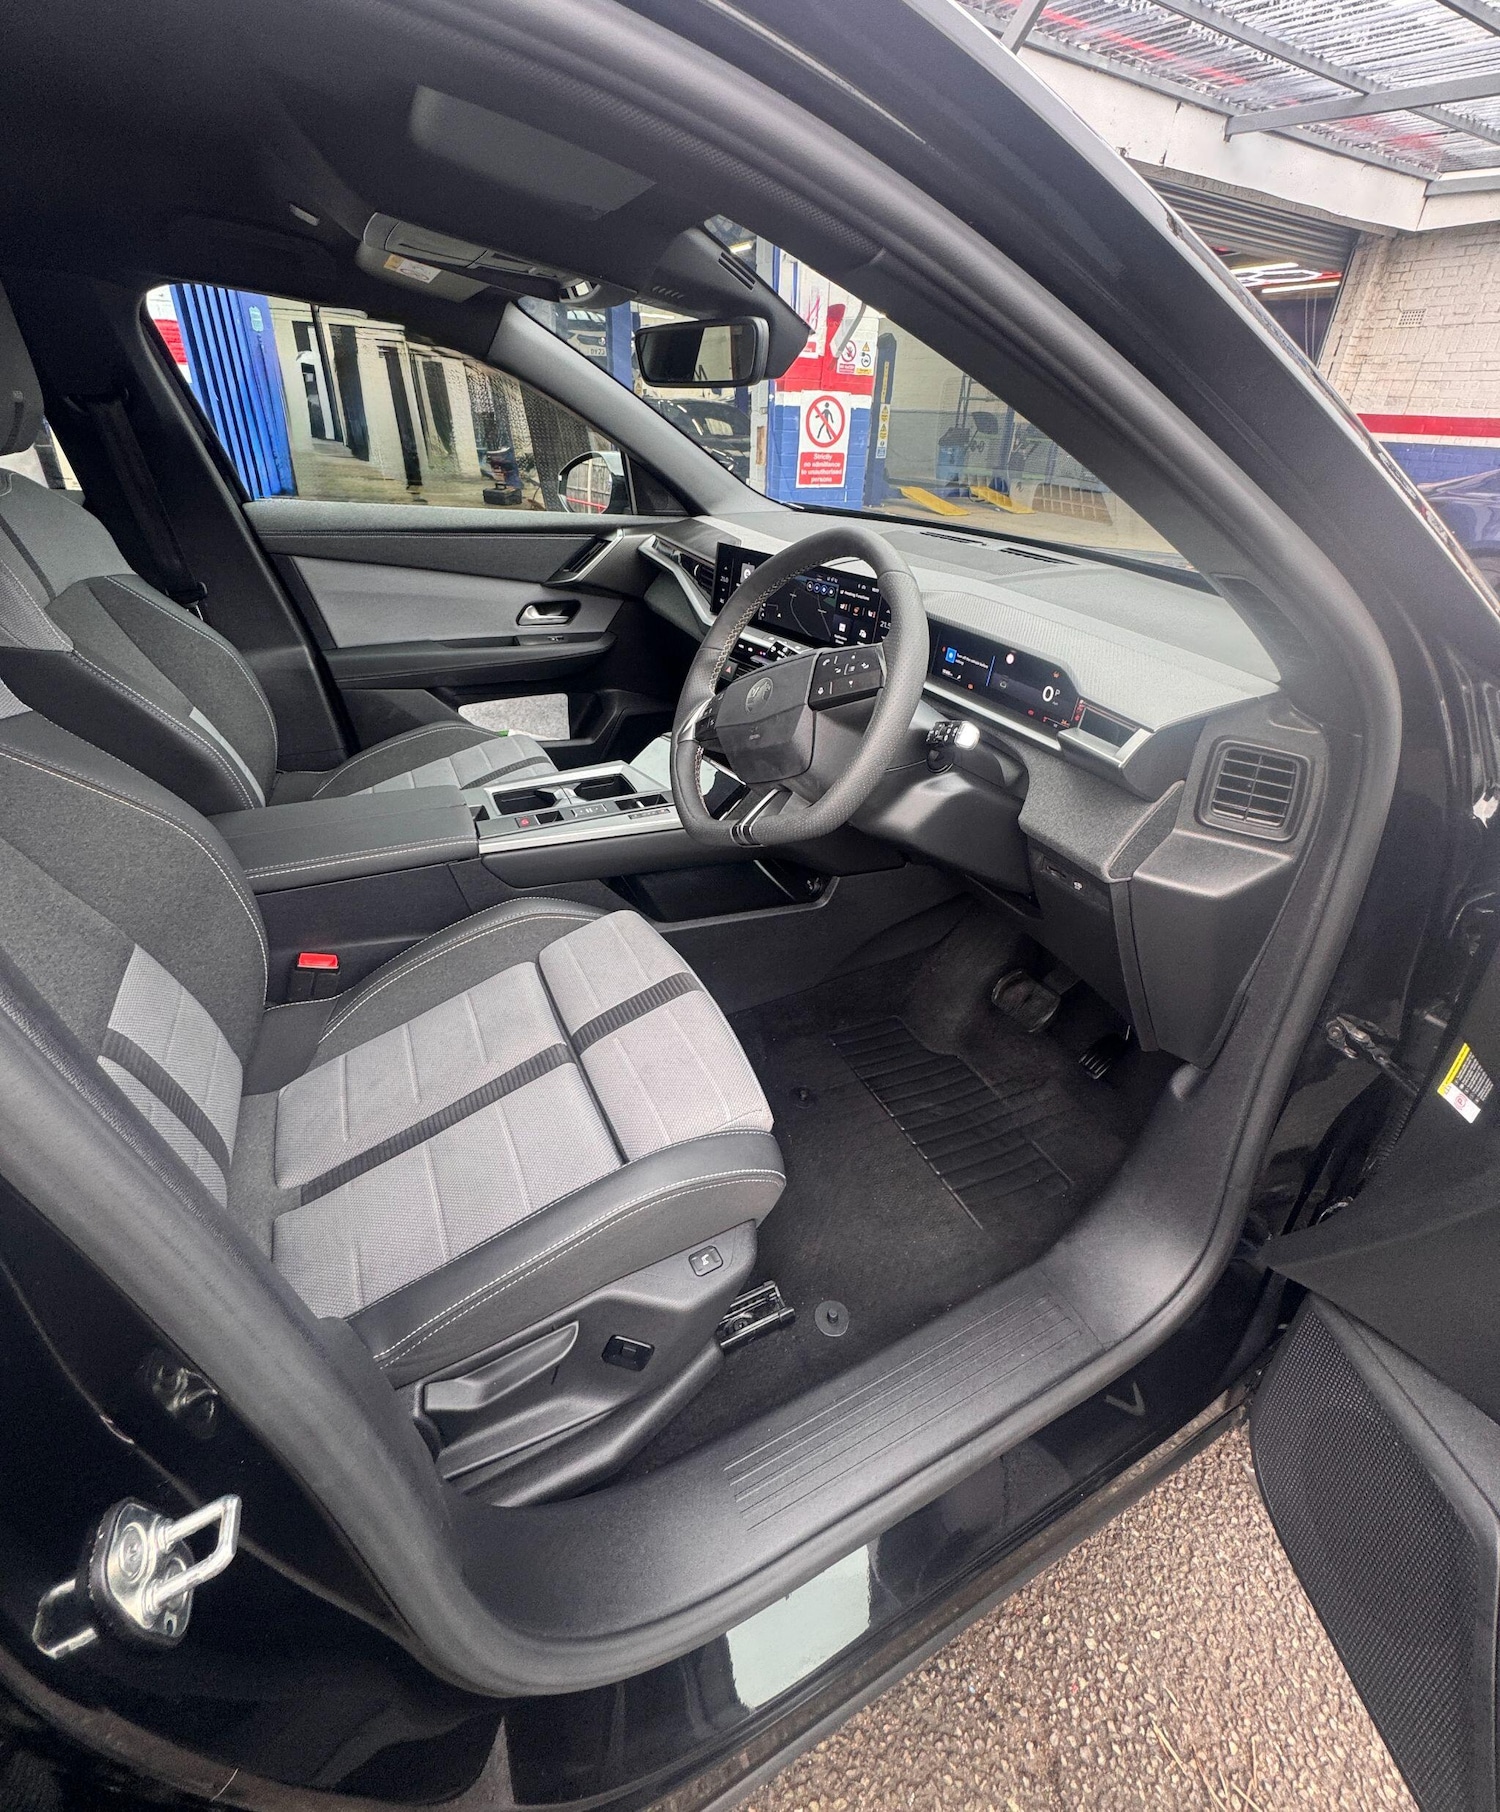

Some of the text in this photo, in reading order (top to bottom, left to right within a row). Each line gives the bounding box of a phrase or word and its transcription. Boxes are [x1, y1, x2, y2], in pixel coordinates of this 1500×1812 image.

[813, 453, 833, 461] Strictly
[1042, 686, 1061, 702] 0 P
